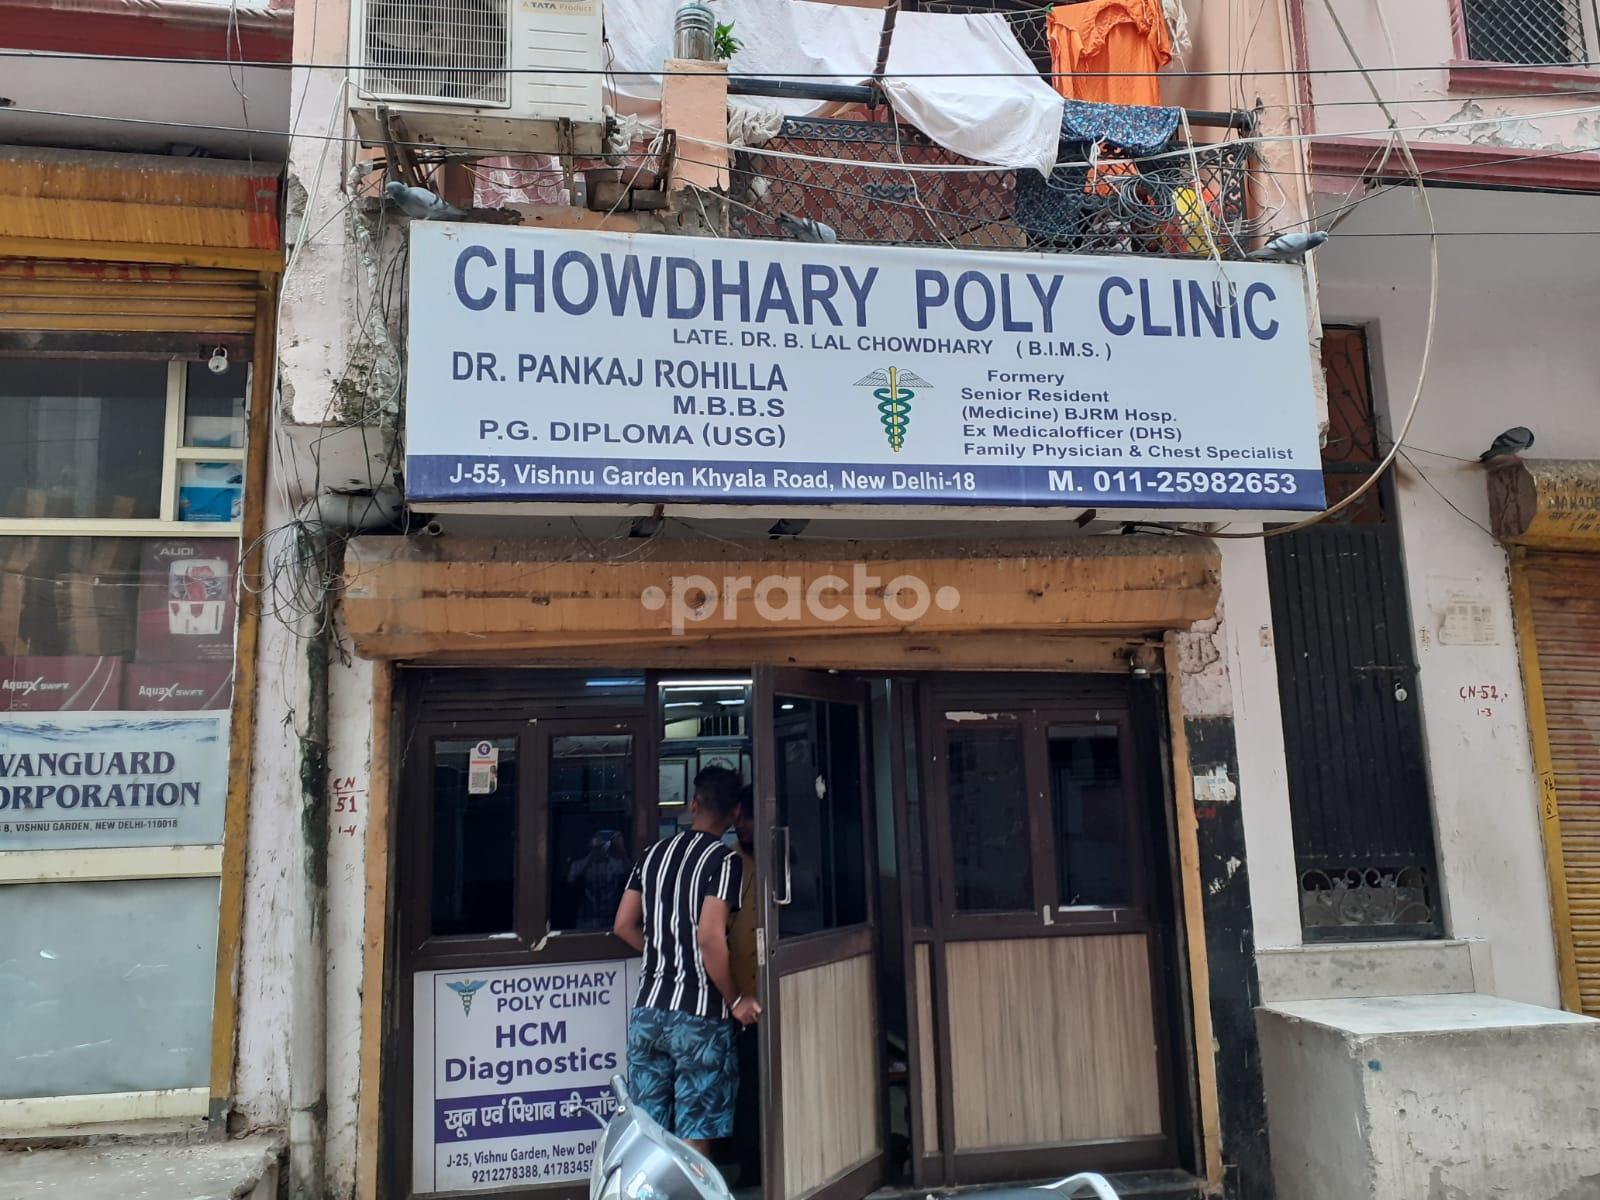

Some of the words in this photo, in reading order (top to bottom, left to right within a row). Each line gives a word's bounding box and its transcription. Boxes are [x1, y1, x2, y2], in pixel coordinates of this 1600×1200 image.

[531, 2, 557, 10] TATA
[454, 245, 879, 327] CHOWDHARY
[915, 269, 1064, 333] POLY
[1099, 275, 1280, 341] CLINIC
[673, 328, 734, 347] LATE.
[741, 331, 777, 348] DR.
[785, 333, 803, 349] B.
[812, 333, 851, 351] LAL
[858, 335, 993, 356] CHOWDHARY
[452, 351, 506, 381] DR.
[518, 355, 643, 387] PANKAJ
[655, 359, 788, 391] ROHILLA
[987, 370, 1065, 387] Formery
[961, 387, 1021, 402] Senior
[1027, 389, 1109, 403] Resident
[673, 396, 785, 417] M.B.B.S
[962, 406, 1059, 423] (Medicine)
[1065, 407, 1119, 421] BJRM
[1125, 408, 1177, 425] Hosp.
[479, 420, 537, 441] P.G.
[550, 422, 694, 446] DIPLOMA
[703, 423, 786, 449] (USG)
[963, 425, 985, 438] Ex
[1129, 428, 1183, 443] (DHS)
[964, 442, 1026, 460] Family
[1032, 443, 1123, 460] Physician
[1130, 445, 1142, 459] &
[1149, 445, 1201, 460] Chest
[1207, 446, 1294, 463] Specialist
[449, 463, 506, 488] J-55,
[514, 464, 595, 488] Vishnu
[602, 466, 684, 489] Garden
[693, 468, 766, 493] Khyala
[774, 470, 834, 493] Road,
[841, 471, 884, 491] New
[892, 472, 976, 492] Delhi-18
[1048, 470, 1083, 493] M.
[1093, 471, 1297, 495] 011-25982653
[332, 776, 356, 792] CN
[335, 796, 357, 813] 51
[17, 823, 50, 832] VISHNU
[95, 821, 115, 830] NEW
[118, 820, 178, 829] DELHI-110018
[490, 971, 616, 994] CHOWDHARY
[497, 995, 544, 1012] POLY
[550, 990, 610, 1007] CLINIC
[496, 1021, 567, 1048] HCM
[445, 1047, 617, 1085] Diagnostics
[444, 1107, 477, 1138] खून
[481, 1098, 507, 1127] एवं
[508, 1096, 556, 1124] पिशाब
[559, 1091, 582, 1118] की
[446, 1153, 472, 1167] J-25,
[474, 1149, 508, 1164] Vishnu
[511, 1146, 549, 1161] Garden,
[552, 1143, 575, 1156] New
[472, 1164, 541, 1183] 9212278388,
